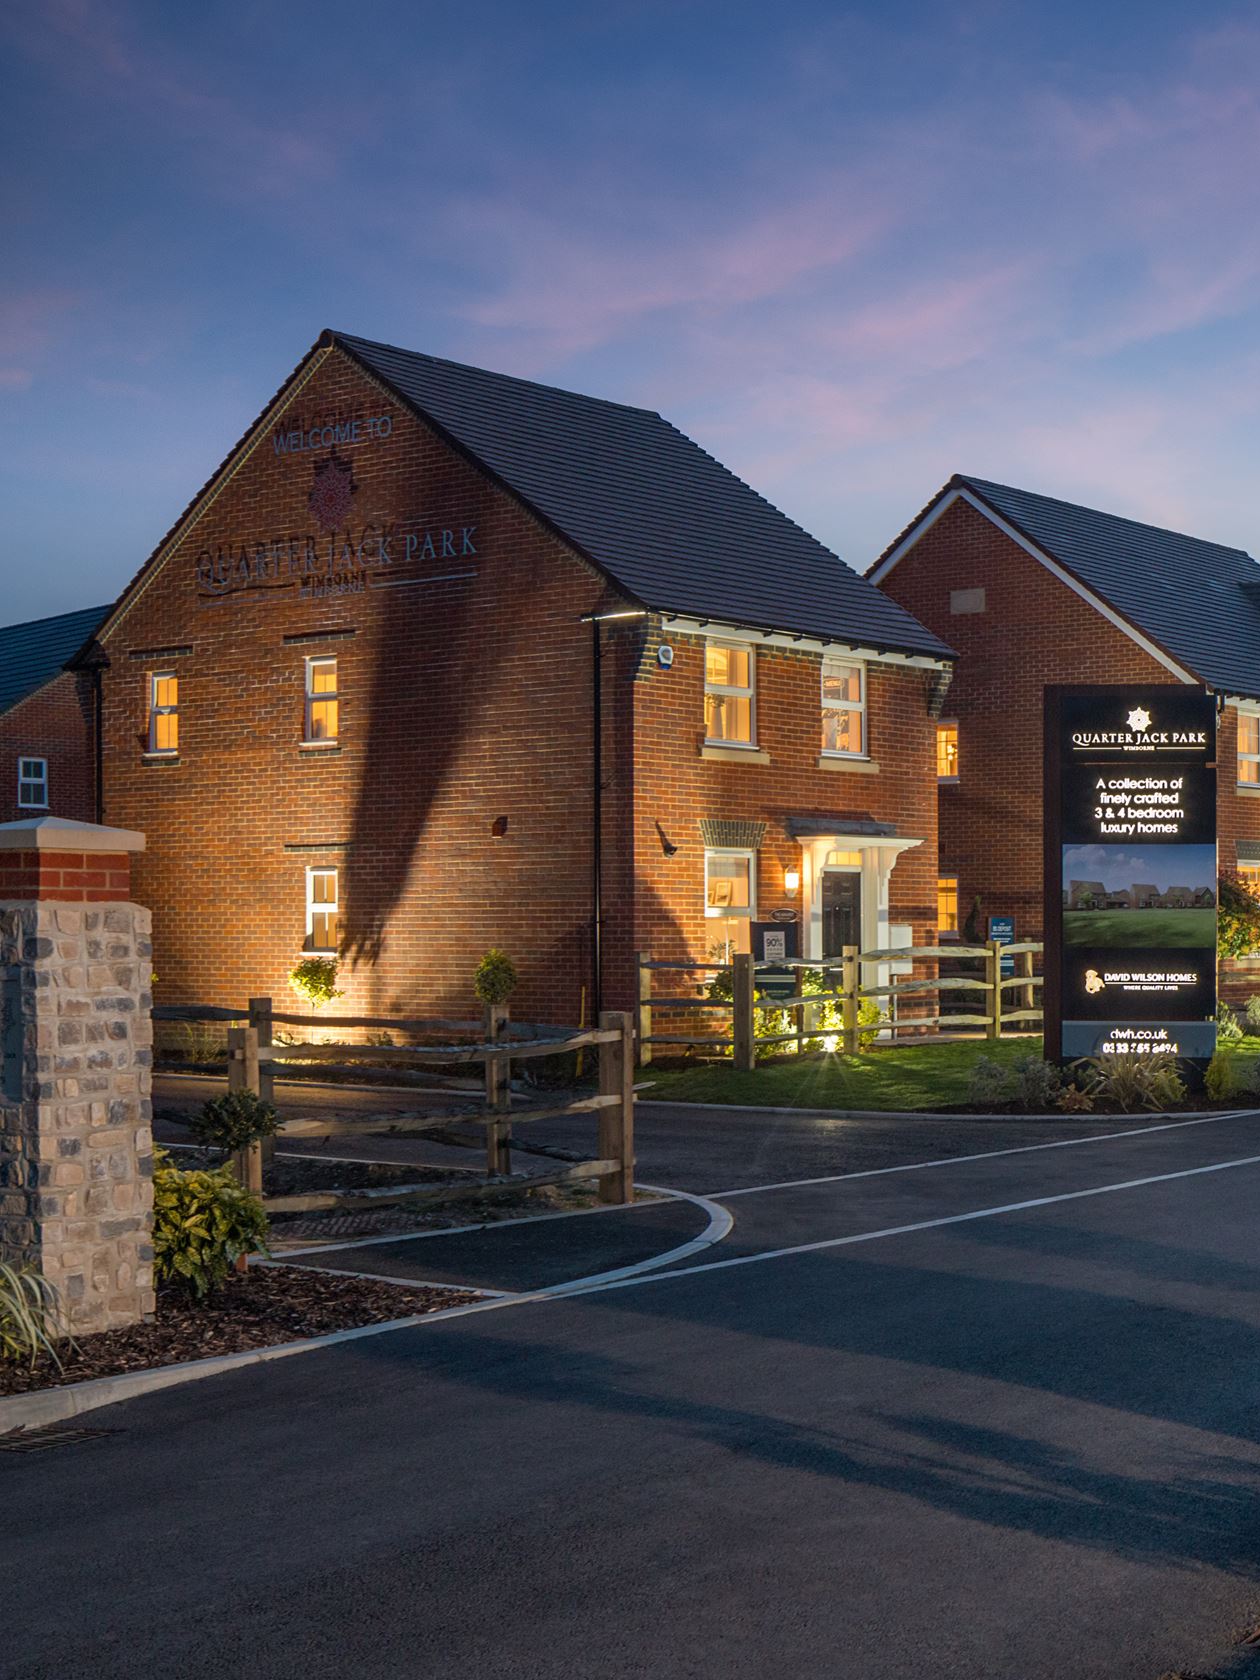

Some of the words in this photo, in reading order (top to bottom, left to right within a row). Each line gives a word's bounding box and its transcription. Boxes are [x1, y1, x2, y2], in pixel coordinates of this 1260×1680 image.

[273, 421, 362, 456] WELCOME
[367, 416, 393, 438] TO
[196, 546, 319, 595] QUARTER
[324, 537, 393, 578] JACK
[405, 526, 478, 561] PARK
[1072, 733, 1133, 746] QUARTER
[1135, 733, 1168, 745] JACK
[1172, 732, 1206, 743] PARK
[1096, 778, 1106, 789] A
[1108, 778, 1167, 789] collection
[1170, 777, 1183, 789] of
[1100, 792, 1131, 806] finely
[1134, 792, 1179, 804] crafted
[1095, 807, 1102, 818] 3
[1105, 807, 1115, 818] &
[1117, 807, 1125, 818] 4
[1127, 807, 1184, 818] bedroom
[1100, 822, 1134, 835] luxury
[1137, 822, 1178, 833] homes
[1104, 973, 1130, 981] DAVID
[1131, 973, 1165, 981] WILSON
[1166, 973, 1197, 981] HOMES
[1110, 1028, 1168, 1039] dwh.co.uk
